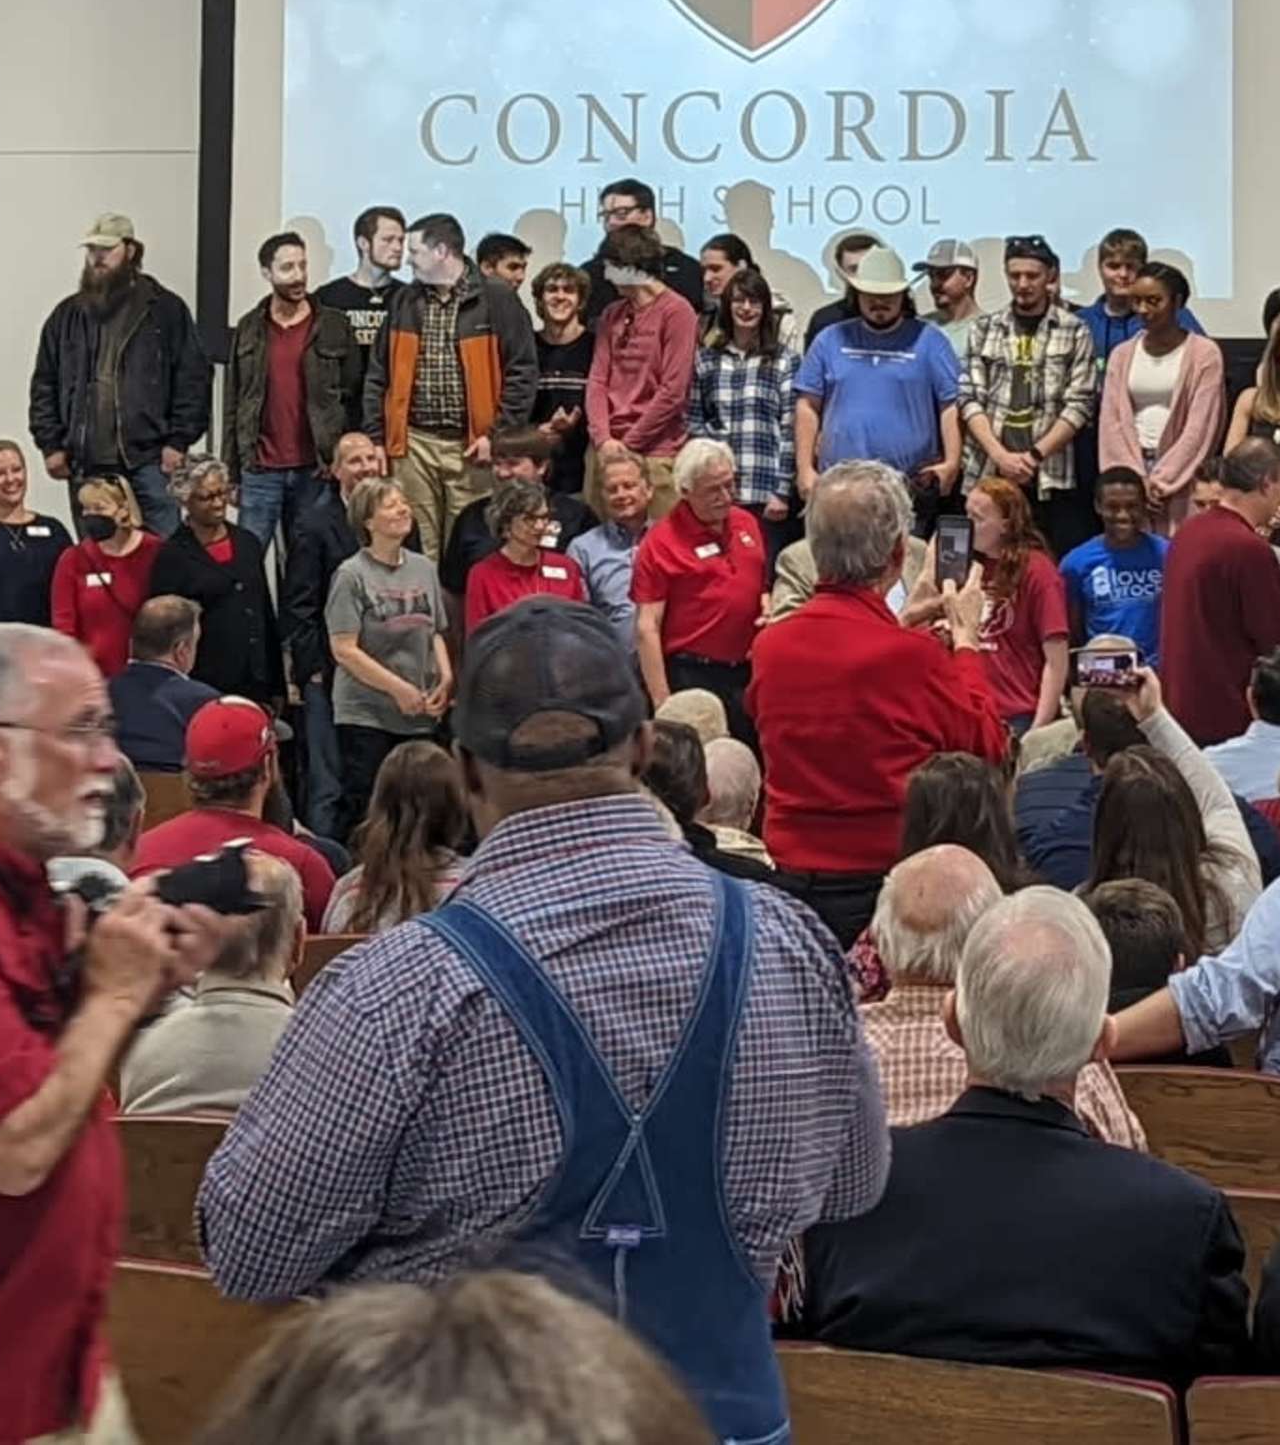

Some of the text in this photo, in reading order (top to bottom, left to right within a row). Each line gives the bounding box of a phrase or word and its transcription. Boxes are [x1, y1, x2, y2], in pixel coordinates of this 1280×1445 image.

[419, 87, 1100, 166] CONCORDIA
[560, 183, 941, 226] HIH SHOOL
[1111, 568, 1163, 586] love
